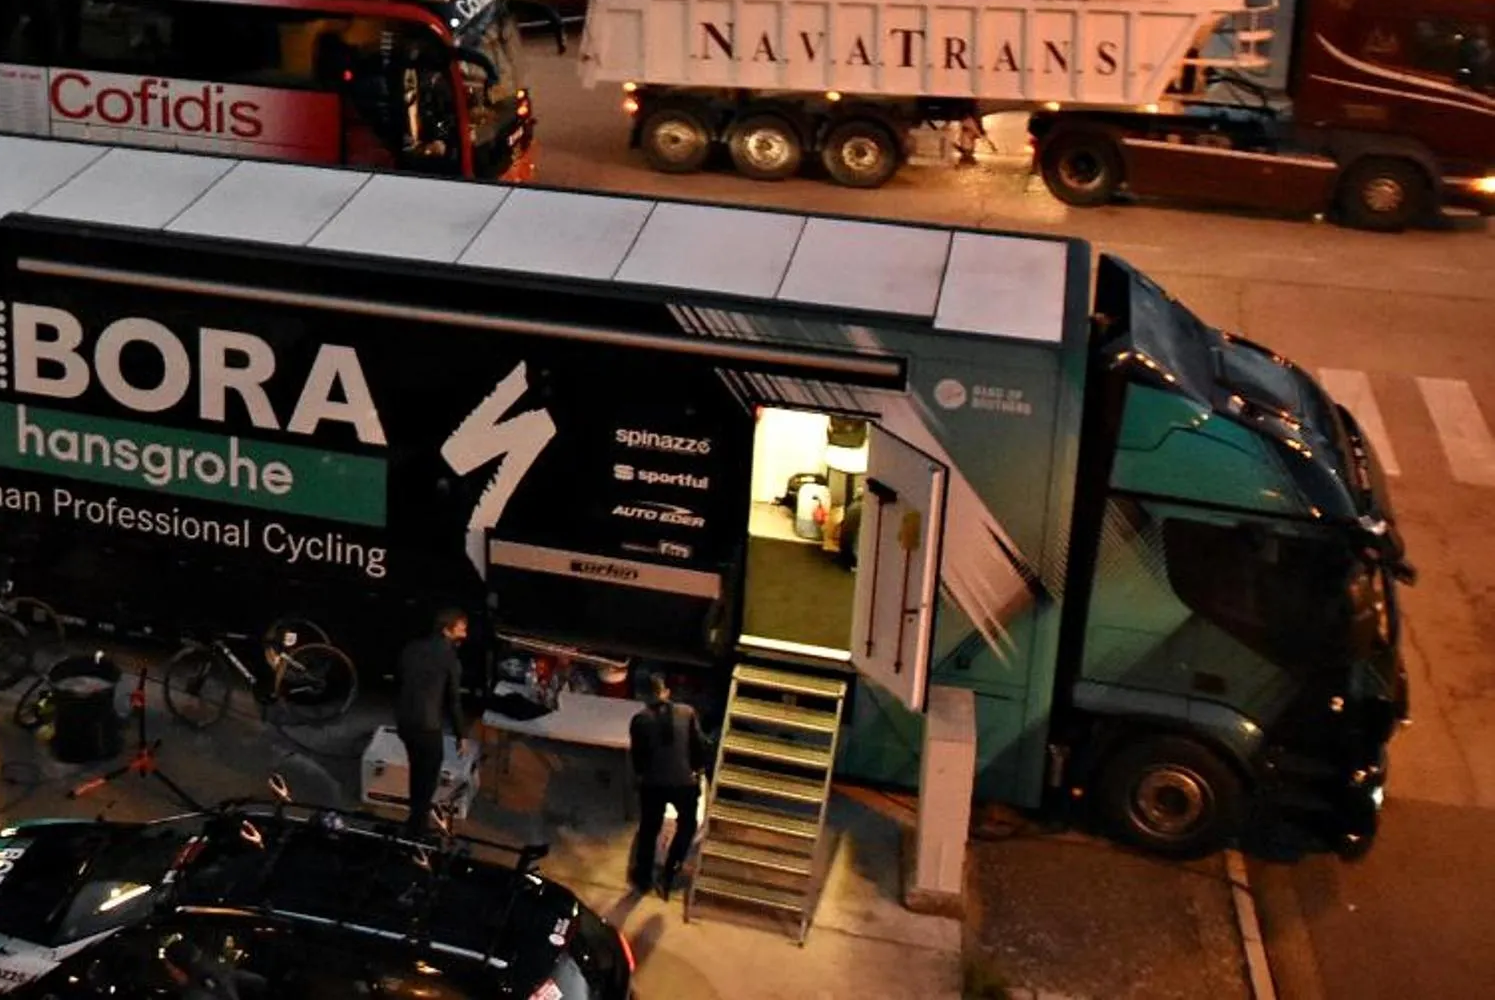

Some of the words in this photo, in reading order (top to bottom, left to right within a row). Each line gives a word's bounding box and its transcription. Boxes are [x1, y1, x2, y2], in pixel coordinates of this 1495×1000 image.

[700, 21, 1118, 77] NAVATRANS
[50, 72, 263, 138] Cofidis
[12, 301, 388, 446] BORA
[15, 403, 294, 496] hansgrohe
[638, 469, 709, 490] sportful
[54, 489, 250, 549] Professional
[262, 523, 388, 578] Cycling
[611, 505, 658, 520] AUTO
